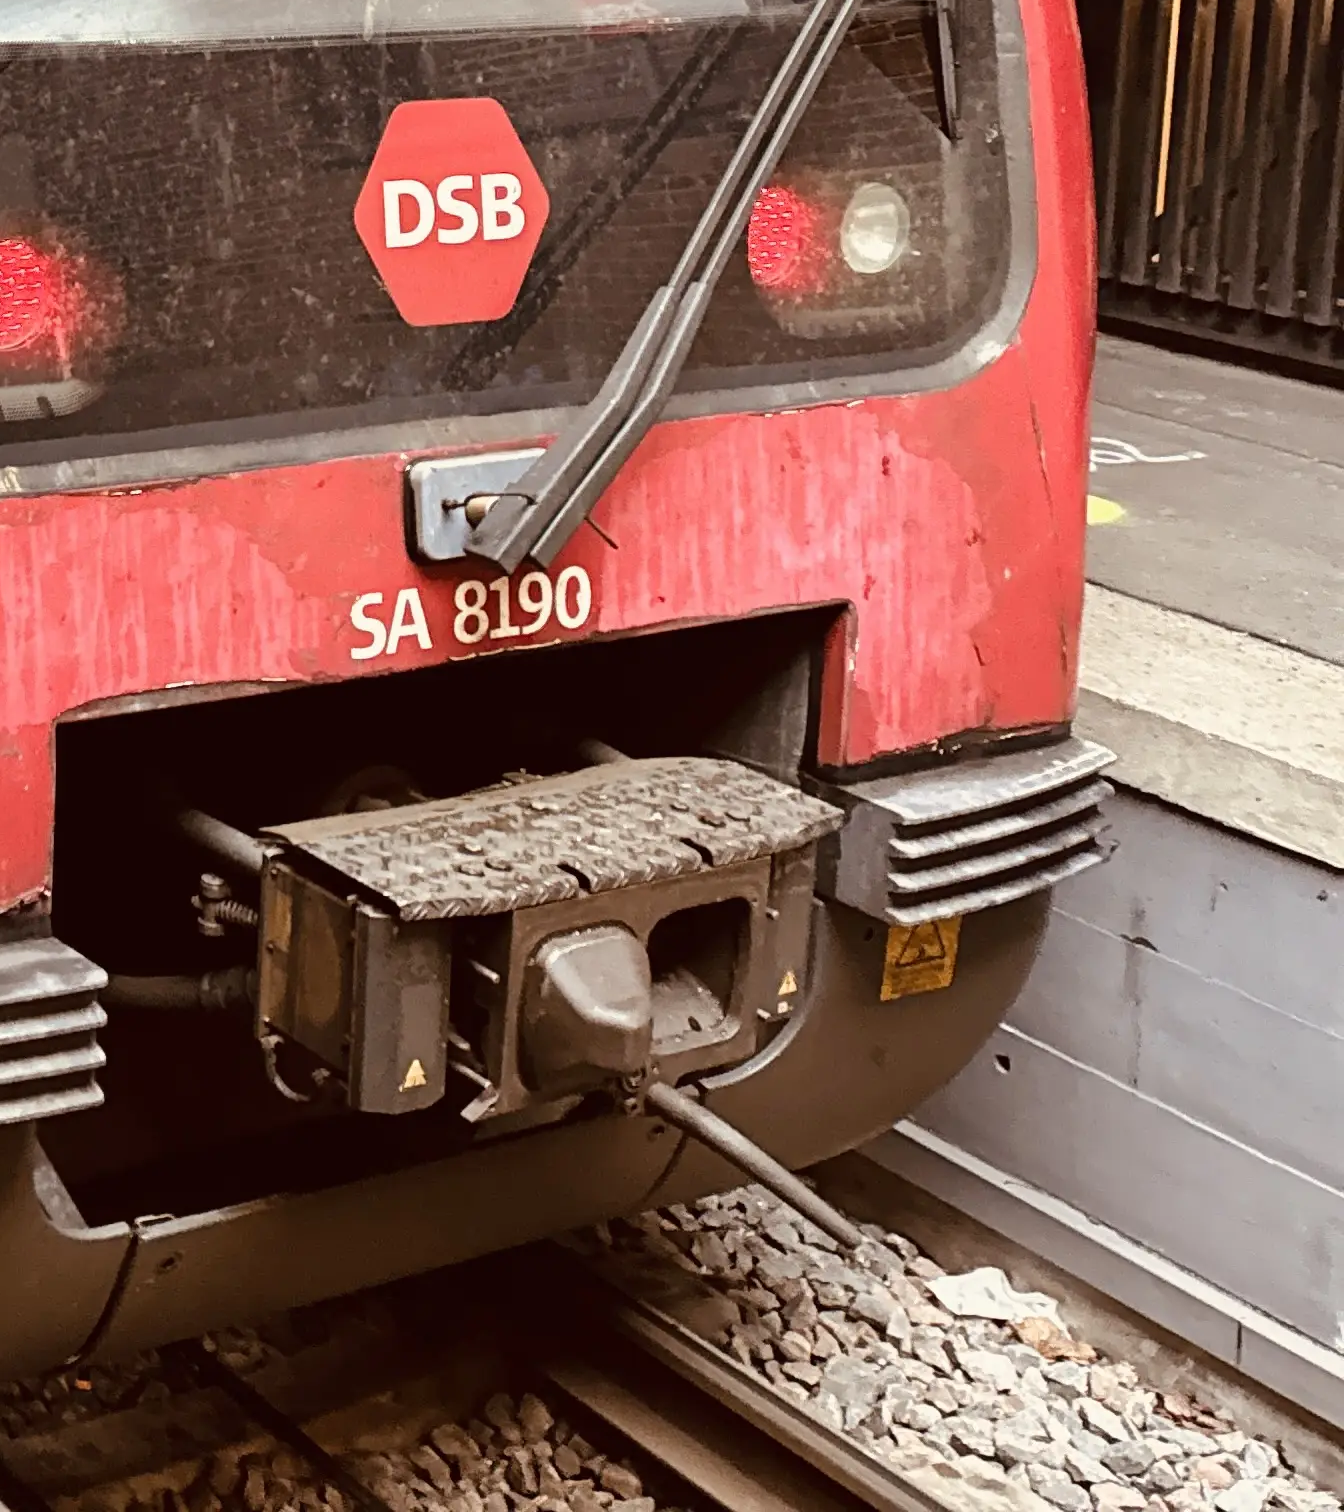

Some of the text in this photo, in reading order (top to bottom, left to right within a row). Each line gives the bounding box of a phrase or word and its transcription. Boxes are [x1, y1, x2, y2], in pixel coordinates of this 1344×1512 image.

[382, 172, 526, 249] DSB
[350, 565, 592, 660] SA 8190
